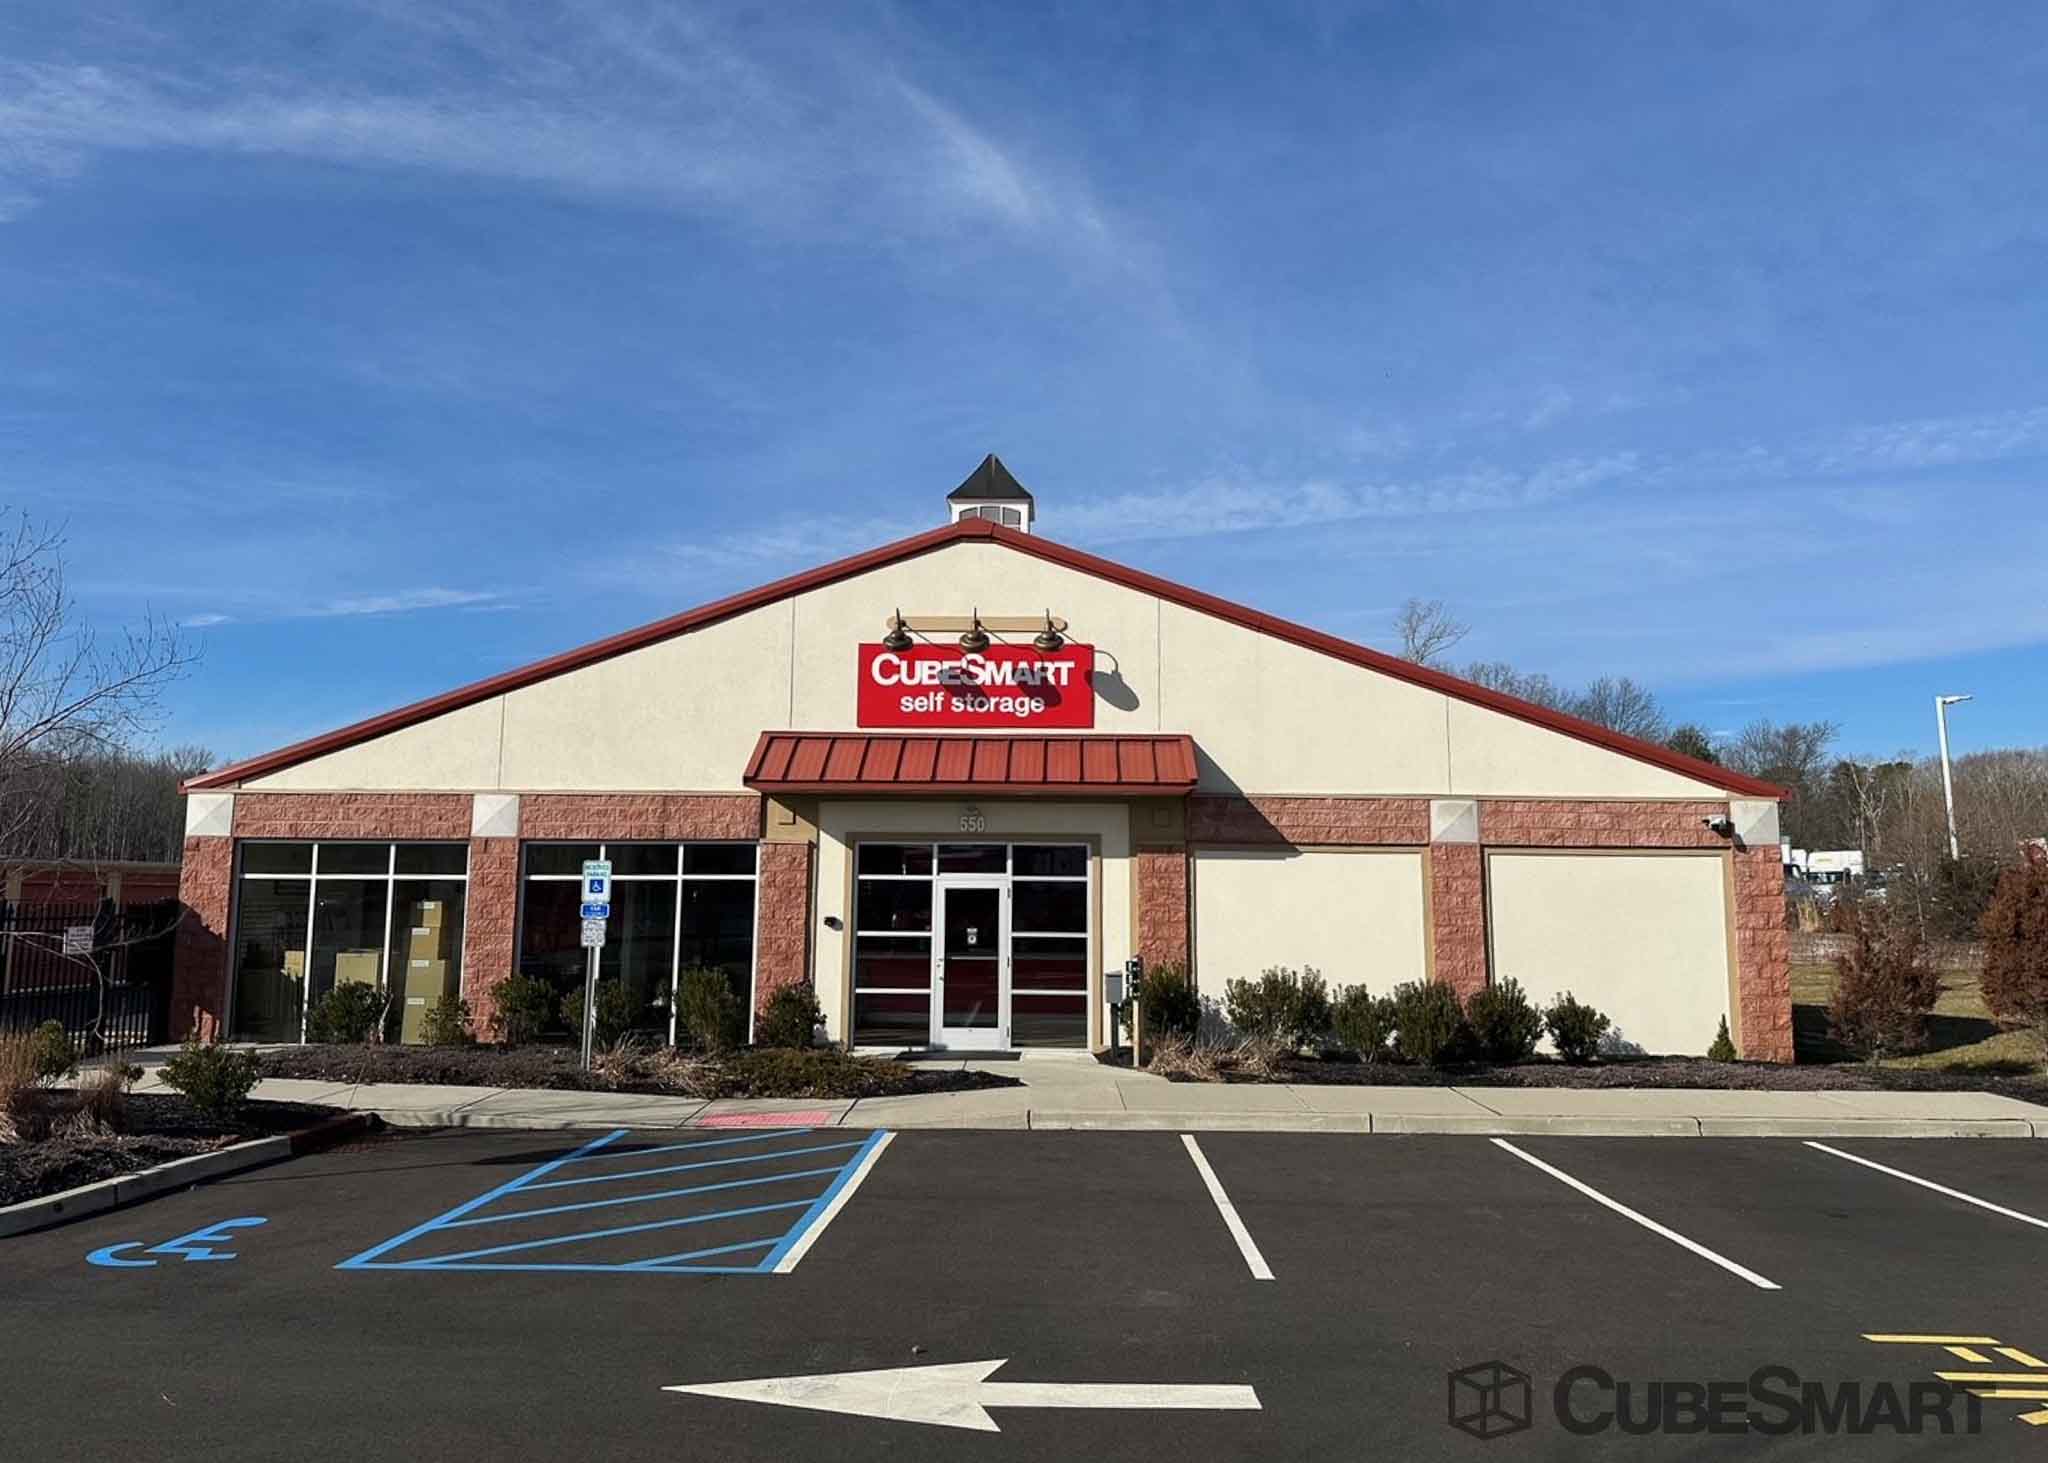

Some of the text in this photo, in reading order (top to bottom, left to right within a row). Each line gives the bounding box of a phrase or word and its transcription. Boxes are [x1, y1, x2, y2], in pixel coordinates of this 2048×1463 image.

[871, 653, 1075, 686] CUBESMART
[900, 691, 1045, 718] self storage
